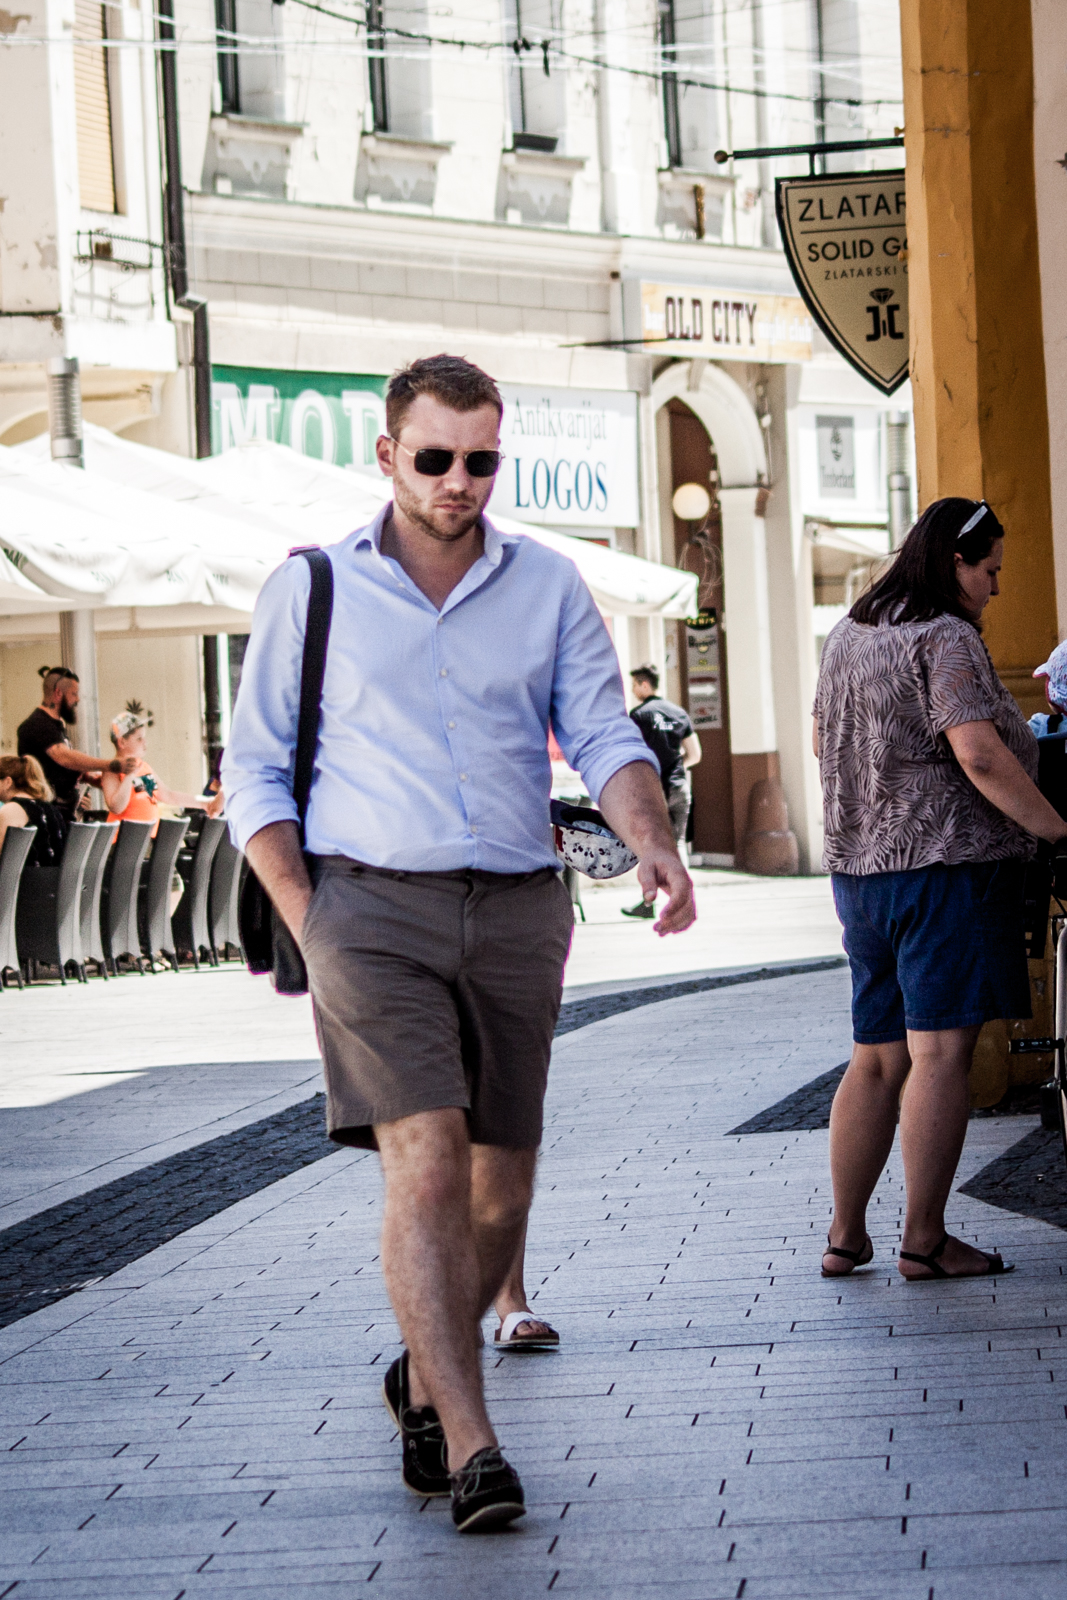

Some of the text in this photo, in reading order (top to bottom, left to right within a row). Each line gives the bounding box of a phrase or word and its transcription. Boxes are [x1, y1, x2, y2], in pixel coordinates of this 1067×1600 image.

[807, 238, 874, 263] SOLID
[824, 265, 897, 281] ZLATARSKI
[665, 296, 704, 342] OLD
[711, 299, 757, 346] CITY
[511, 397, 607, 451] Antikvarijat
[514, 457, 608, 513] LOGOS
